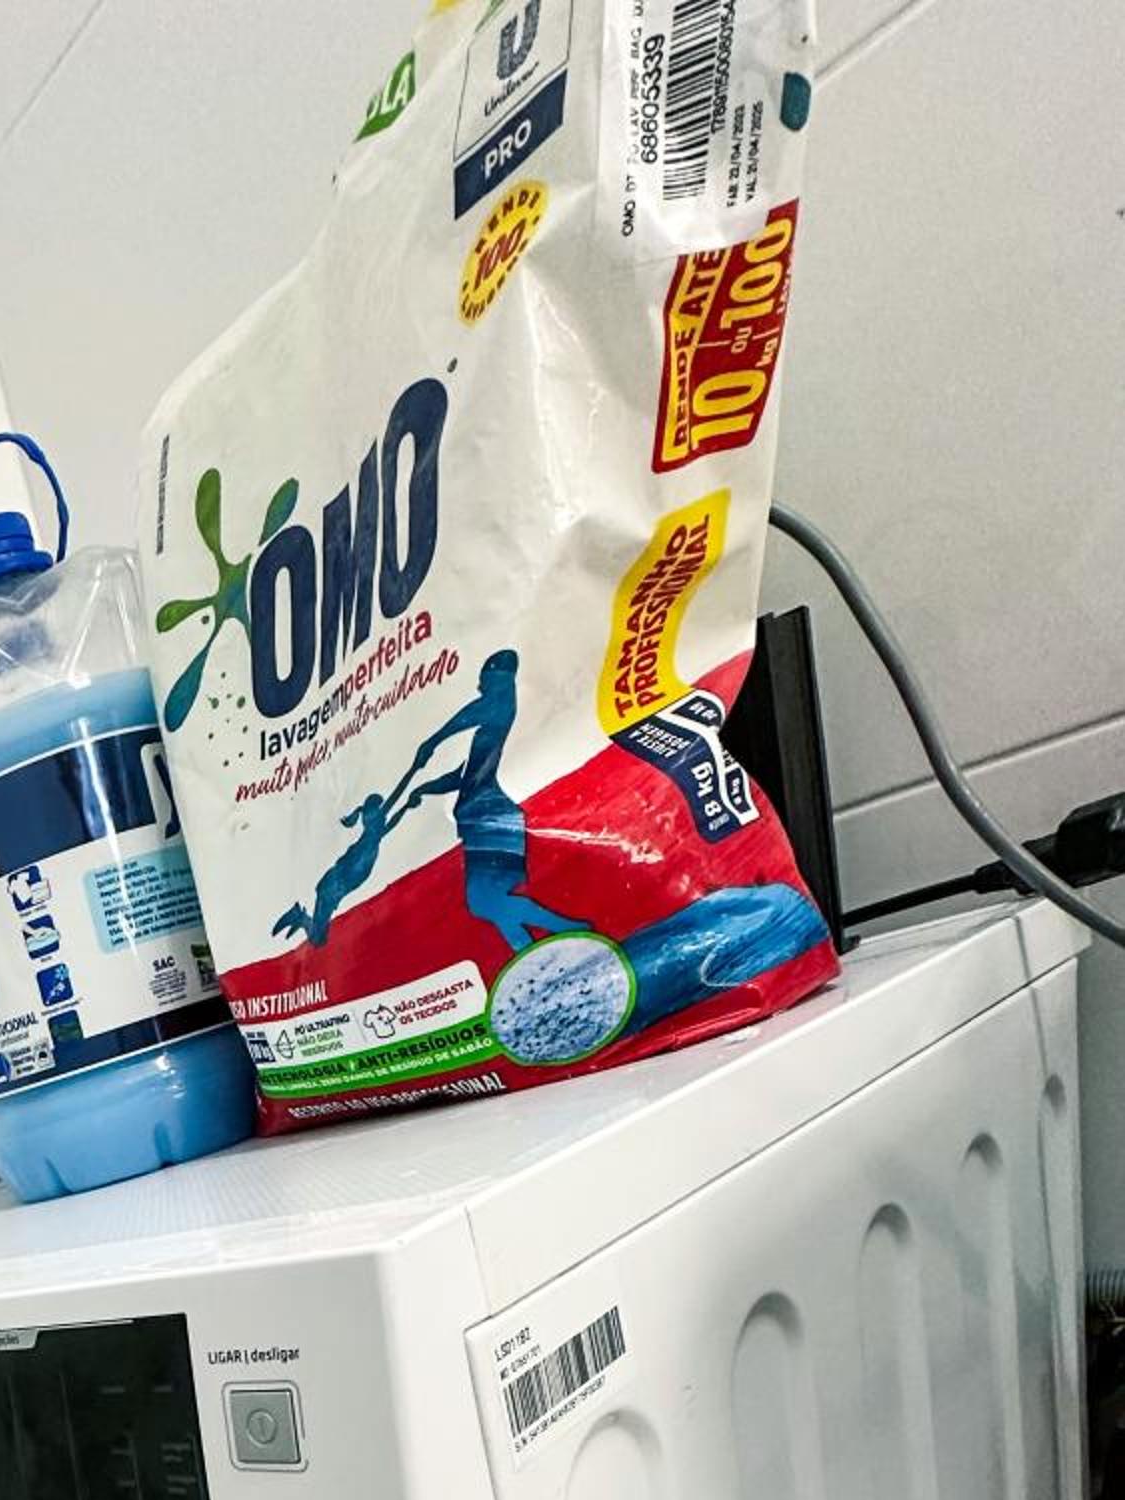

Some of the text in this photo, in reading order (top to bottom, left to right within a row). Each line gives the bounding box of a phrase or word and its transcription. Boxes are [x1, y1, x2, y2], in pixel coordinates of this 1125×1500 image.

[641, 34, 665, 164] 68605339
[483, 119, 532, 180] PRO
[621, 201, 636, 237] OMO
[474, 218, 527, 290] 100
[720, 218, 792, 329] 100
[731, 326, 753, 354] OU
[755, 337, 778, 368] kg
[673, 328, 695, 447] RENDE
[691, 370, 767, 450] 10
[250, 378, 448, 718] OMO
[615, 524, 689, 718] TAMANHO
[636, 514, 711, 710] PROFISSIONAL
[342, 610, 432, 709] perfeita
[691, 761, 714, 798] kg
[704, 800, 722, 817] 8
[153, 955, 176, 972] SAC
[415, 999, 458, 1020] TECIDOS
[416, 979, 474, 1007] DESGASTA
[357, 1022, 487, 1069] ANTI-RESÍDUOS
[451, 1038, 493, 1057] SABÃO
[208, 1347, 299, 1365] LIGAR desligar
